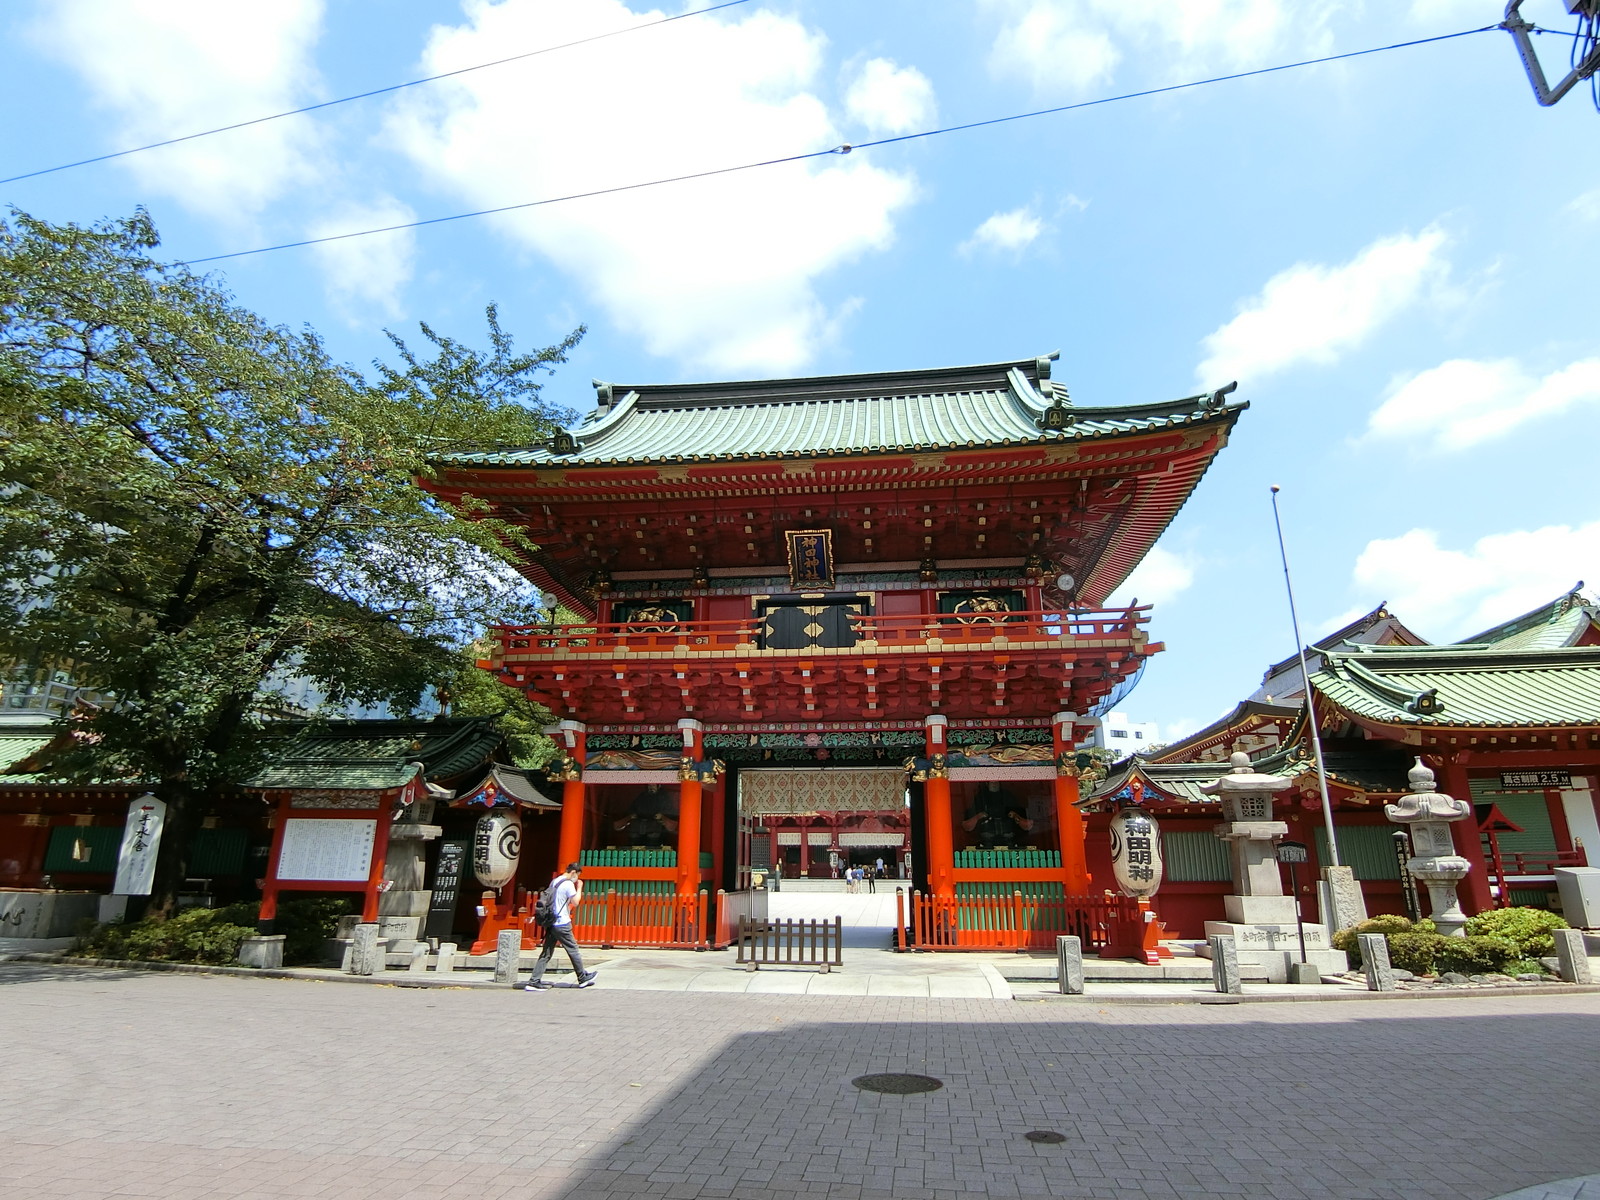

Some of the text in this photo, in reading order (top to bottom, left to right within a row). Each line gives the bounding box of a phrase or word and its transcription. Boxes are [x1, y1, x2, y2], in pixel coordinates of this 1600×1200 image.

[1503, 775, 1539, 784] 高さ制限
[1541, 774, 1559, 783] 2.5
[133, 813, 151, 852] 手水舎
[475, 818, 495, 875] 神田明神
[1125, 820, 1154, 882] 神田明神
